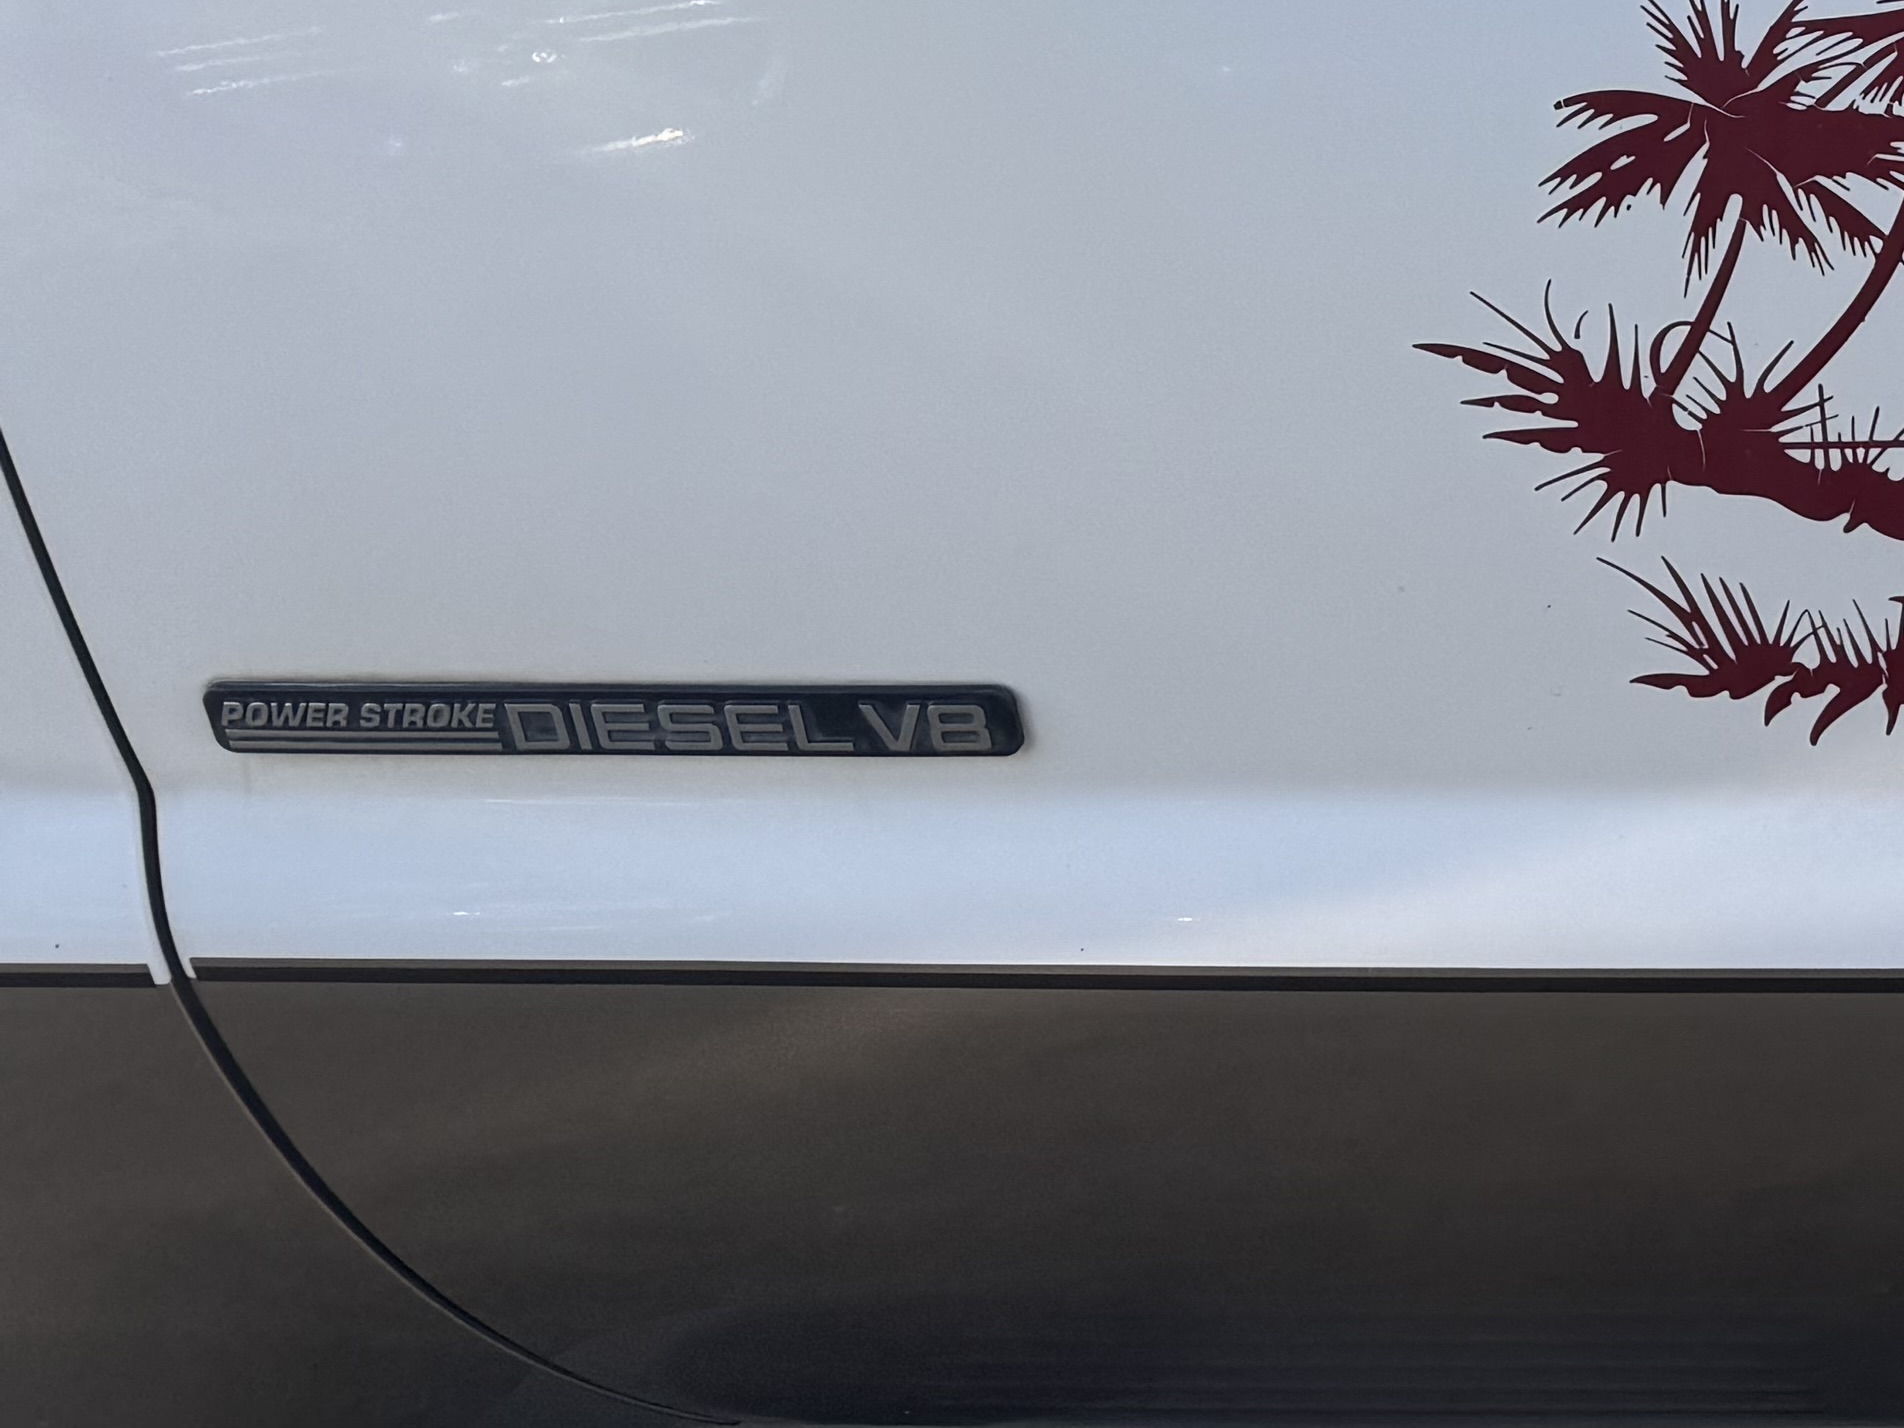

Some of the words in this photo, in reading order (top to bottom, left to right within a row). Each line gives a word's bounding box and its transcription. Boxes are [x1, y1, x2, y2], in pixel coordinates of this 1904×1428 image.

[220, 700, 350, 728] POWER
[359, 701, 497, 729] STROKE
[503, 701, 855, 752] DIESEL
[857, 702, 993, 752] V8
